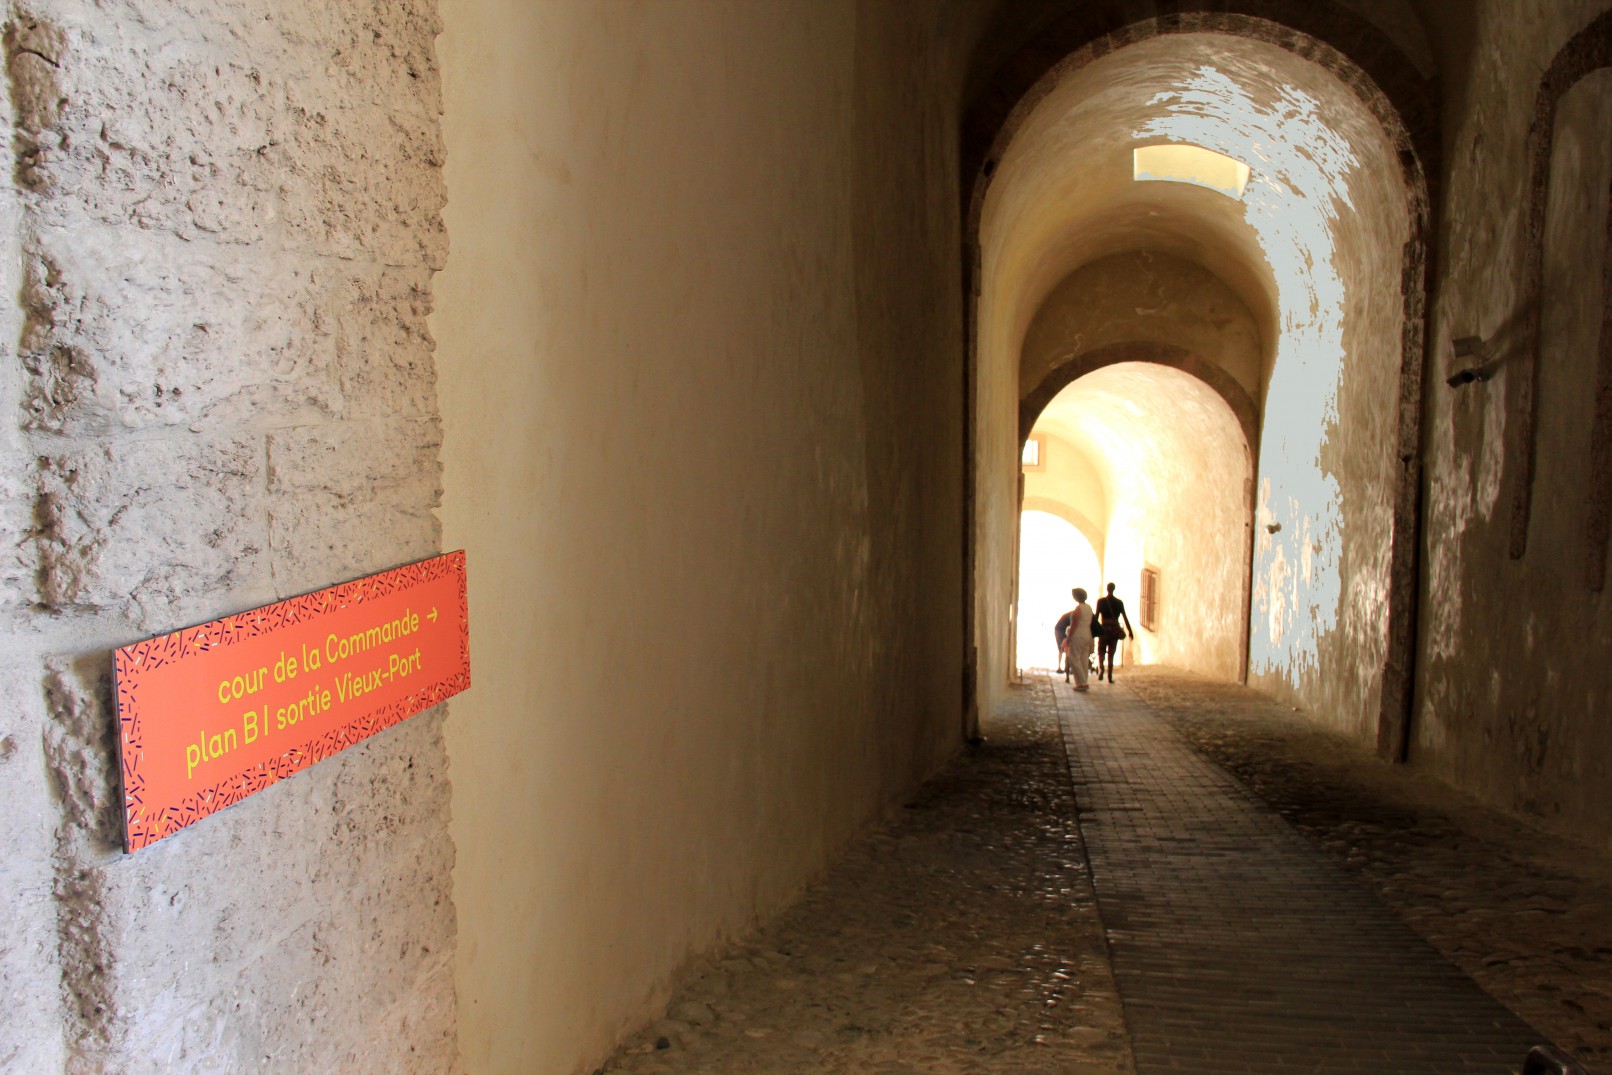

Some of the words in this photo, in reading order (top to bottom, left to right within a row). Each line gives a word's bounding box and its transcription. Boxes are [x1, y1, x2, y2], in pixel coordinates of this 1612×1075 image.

[218, 667, 269, 705] cour
[274, 651, 298, 684] de
[303, 644, 322, 673] la
[326, 608, 419, 664] Commande
[185, 730, 238, 780] plan
[243, 710, 259, 745] B
[276, 684, 332, 731] sortie
[335, 648, 422, 703] Vieux-Port
